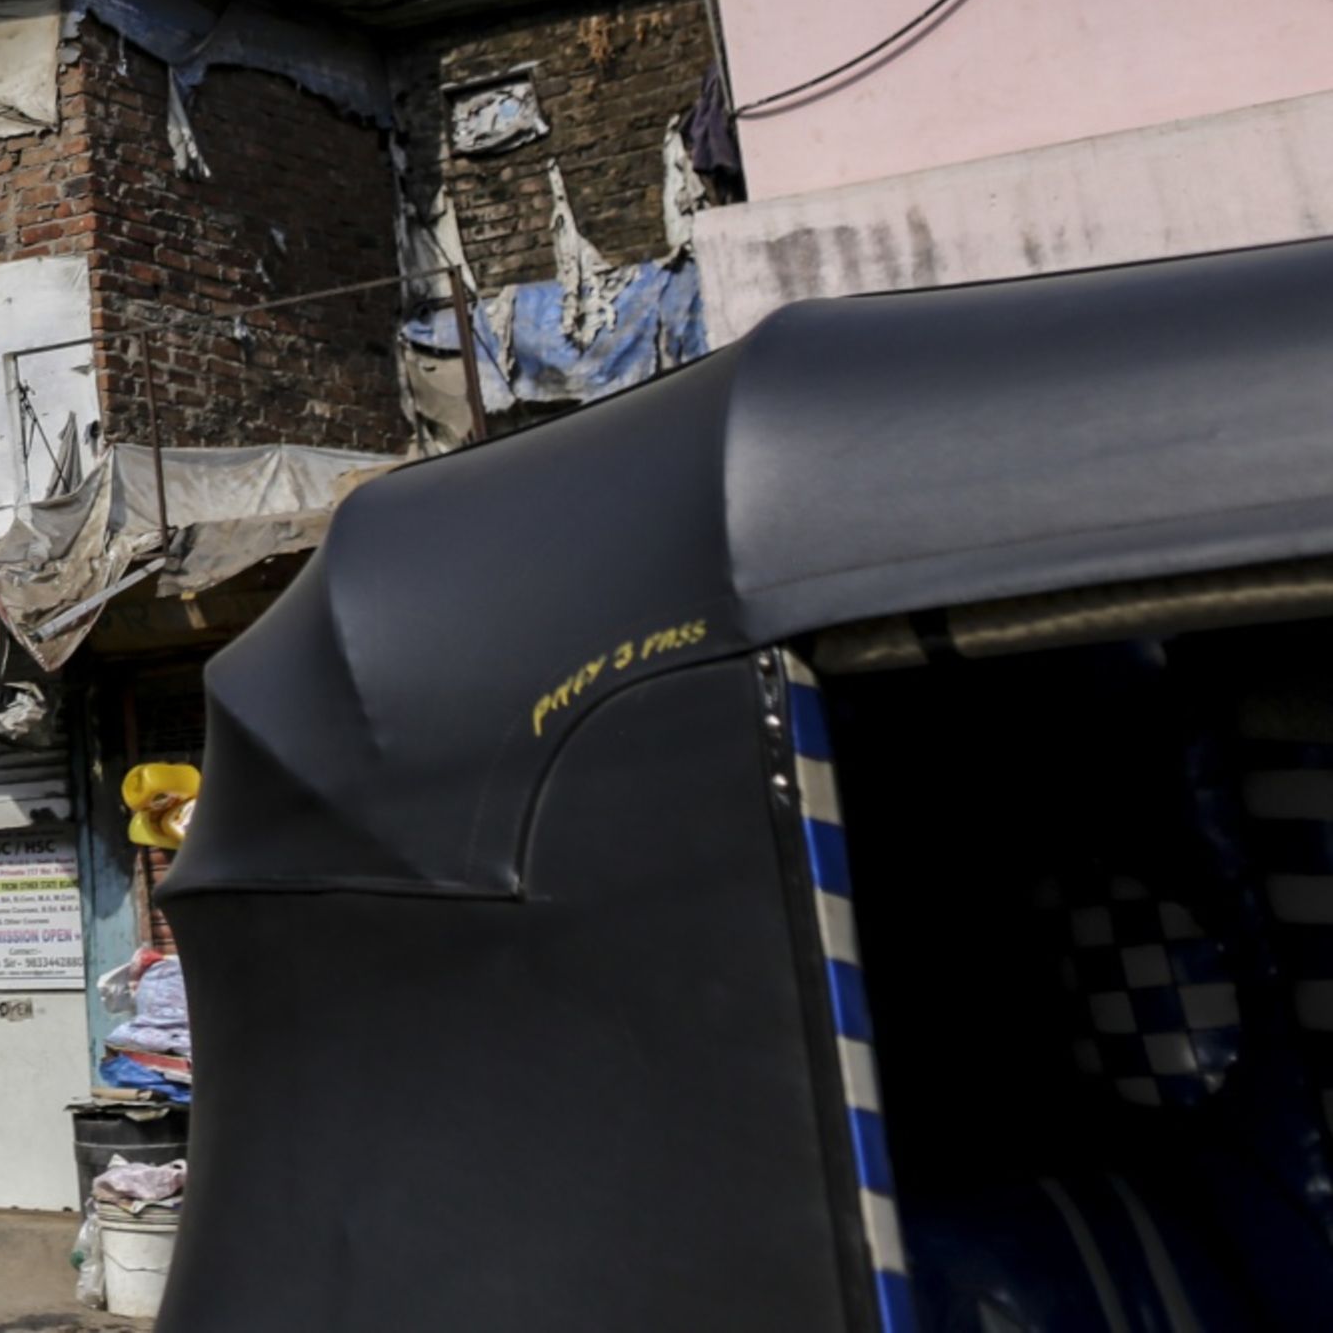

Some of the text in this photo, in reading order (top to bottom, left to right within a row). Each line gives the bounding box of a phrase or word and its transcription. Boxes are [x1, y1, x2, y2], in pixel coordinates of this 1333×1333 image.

[614, 640, 634, 670] 3
[24, 839, 56, 854] HSC
[42, 928, 72, 943] OPEN
